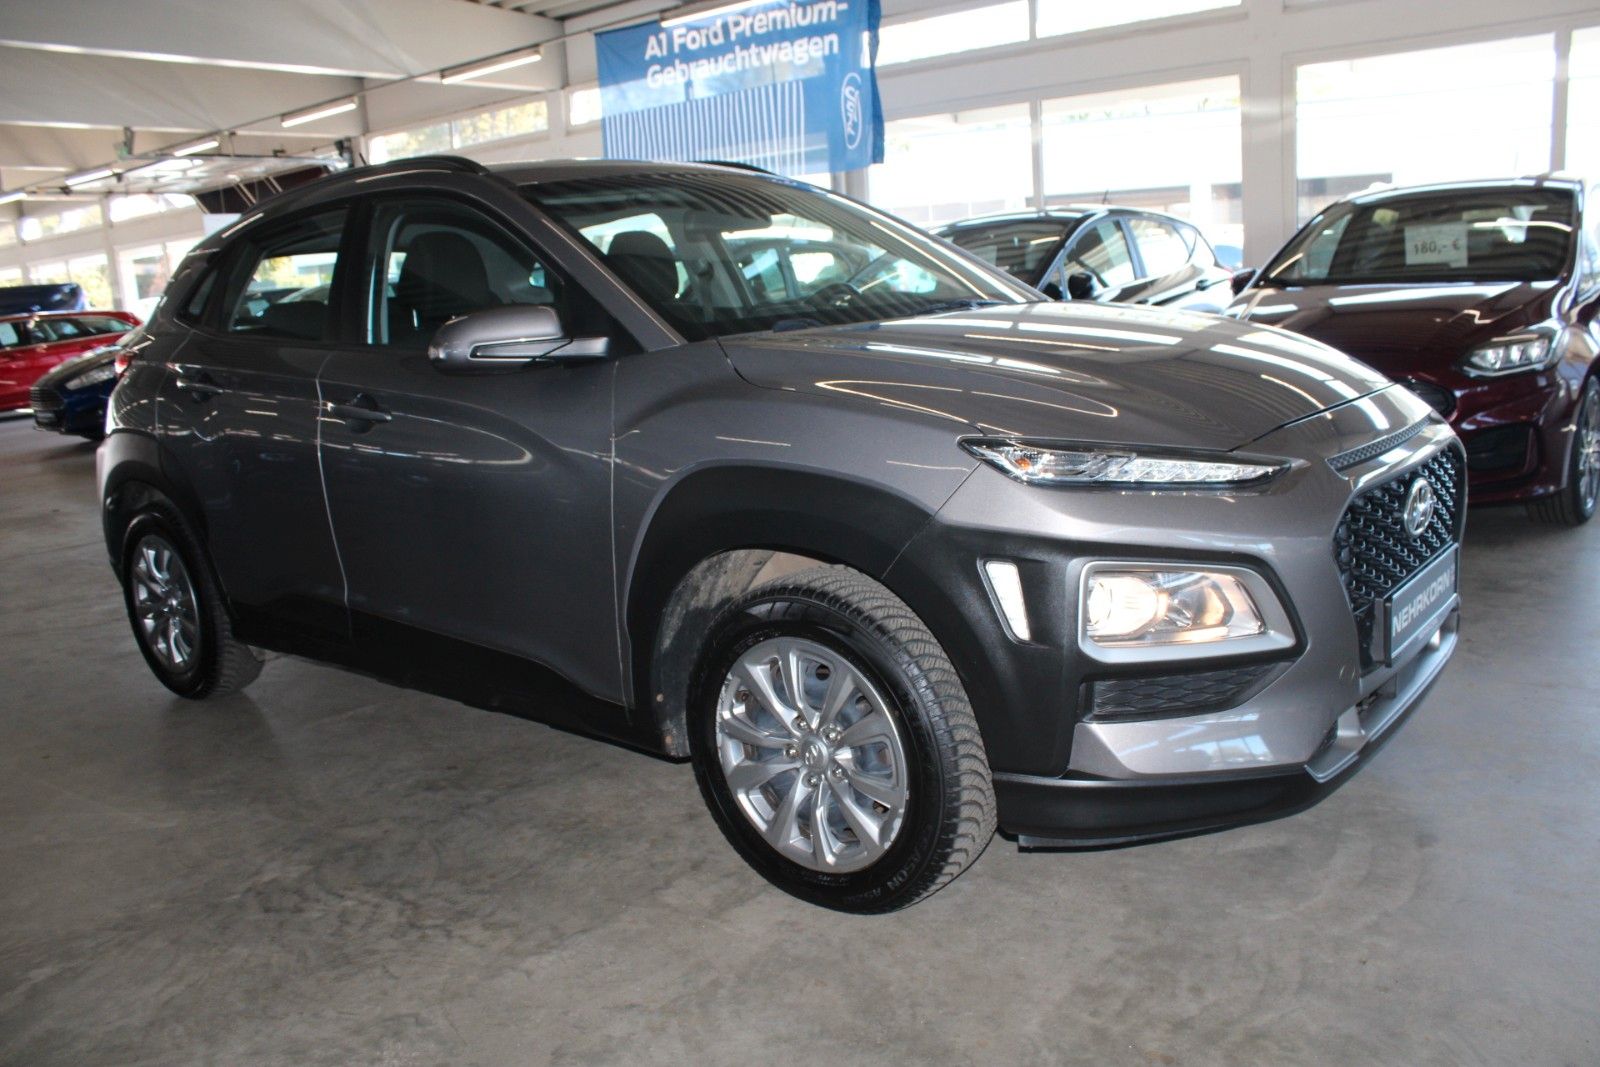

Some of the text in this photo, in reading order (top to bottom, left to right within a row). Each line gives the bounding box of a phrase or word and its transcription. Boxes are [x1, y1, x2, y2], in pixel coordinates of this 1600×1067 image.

[645, 1, 849, 60] A1 Ford Premium-
[646, 33, 839, 89] Gebrauchtwagen
[844, 84, 860, 137] Ford
